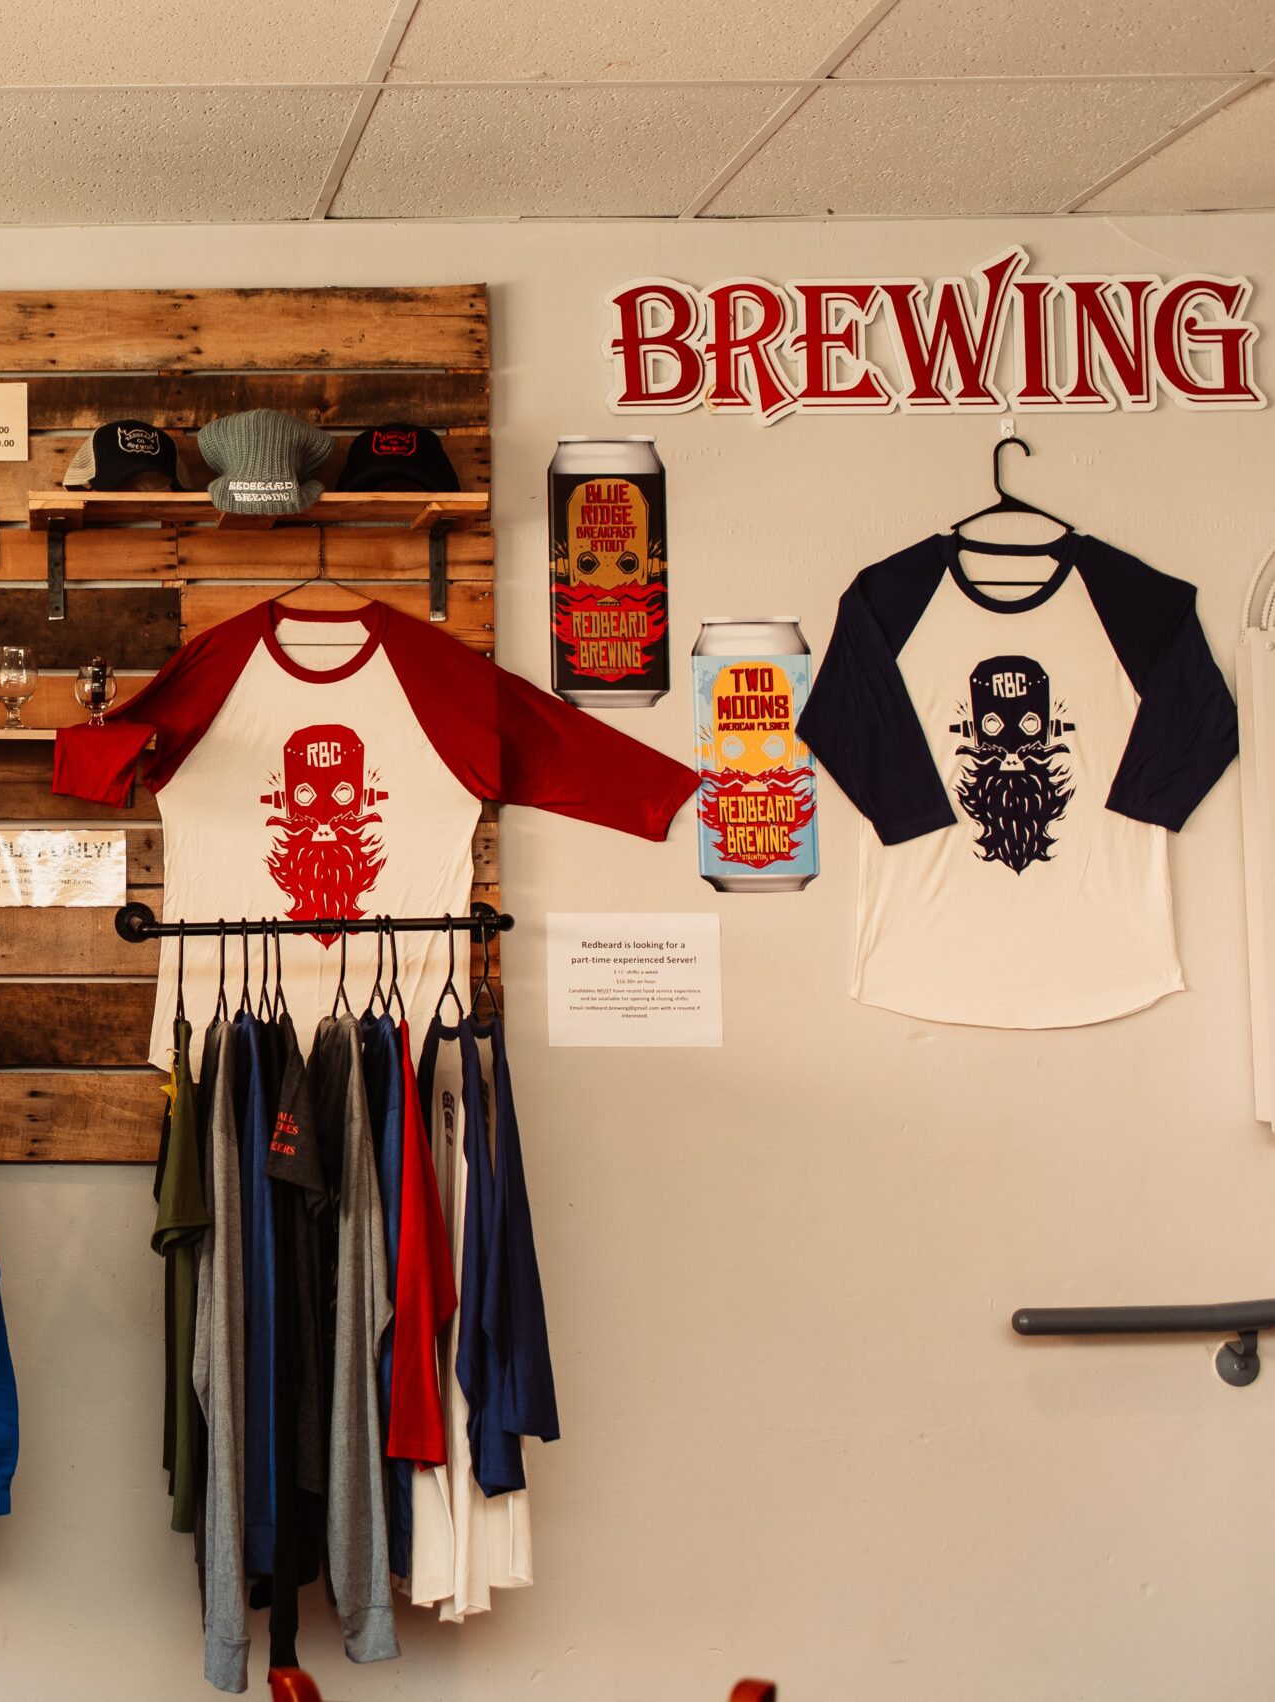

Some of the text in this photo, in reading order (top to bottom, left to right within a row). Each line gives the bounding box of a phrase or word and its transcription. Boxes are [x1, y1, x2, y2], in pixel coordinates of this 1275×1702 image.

[610, 251, 1264, 419] BREWING
[228, 481, 294, 491] REDBEARD
[585, 483, 630, 504] BLUE
[581, 505, 634, 526] RIDGE
[576, 526, 638, 540] BREAKFAST
[590, 540, 627, 553] STOUT
[572, 610, 648, 639] REDBEARD
[579, 640, 641, 668] BREWING
[730, 667, 774, 693] TWO
[992, 672, 1027, 698] RBC
[717, 694, 790, 720] MOONS
[718, 721, 790, 732] AMERICAN PILSNER
[307, 741, 342, 768] RBC
[718, 795, 796, 824] REDBEARD
[726, 826, 789, 854] BREWING
[581, 941, 622, 949] Redbeard
[624, 941, 631, 949] is
[633, 941, 664, 950] looking
[666, 941, 678, 949] for
[571, 956, 697, 965] part-time experienced Server!
[277, 1111, 295, 1124] ALL
[270, 1140, 296, 1156] EERS
